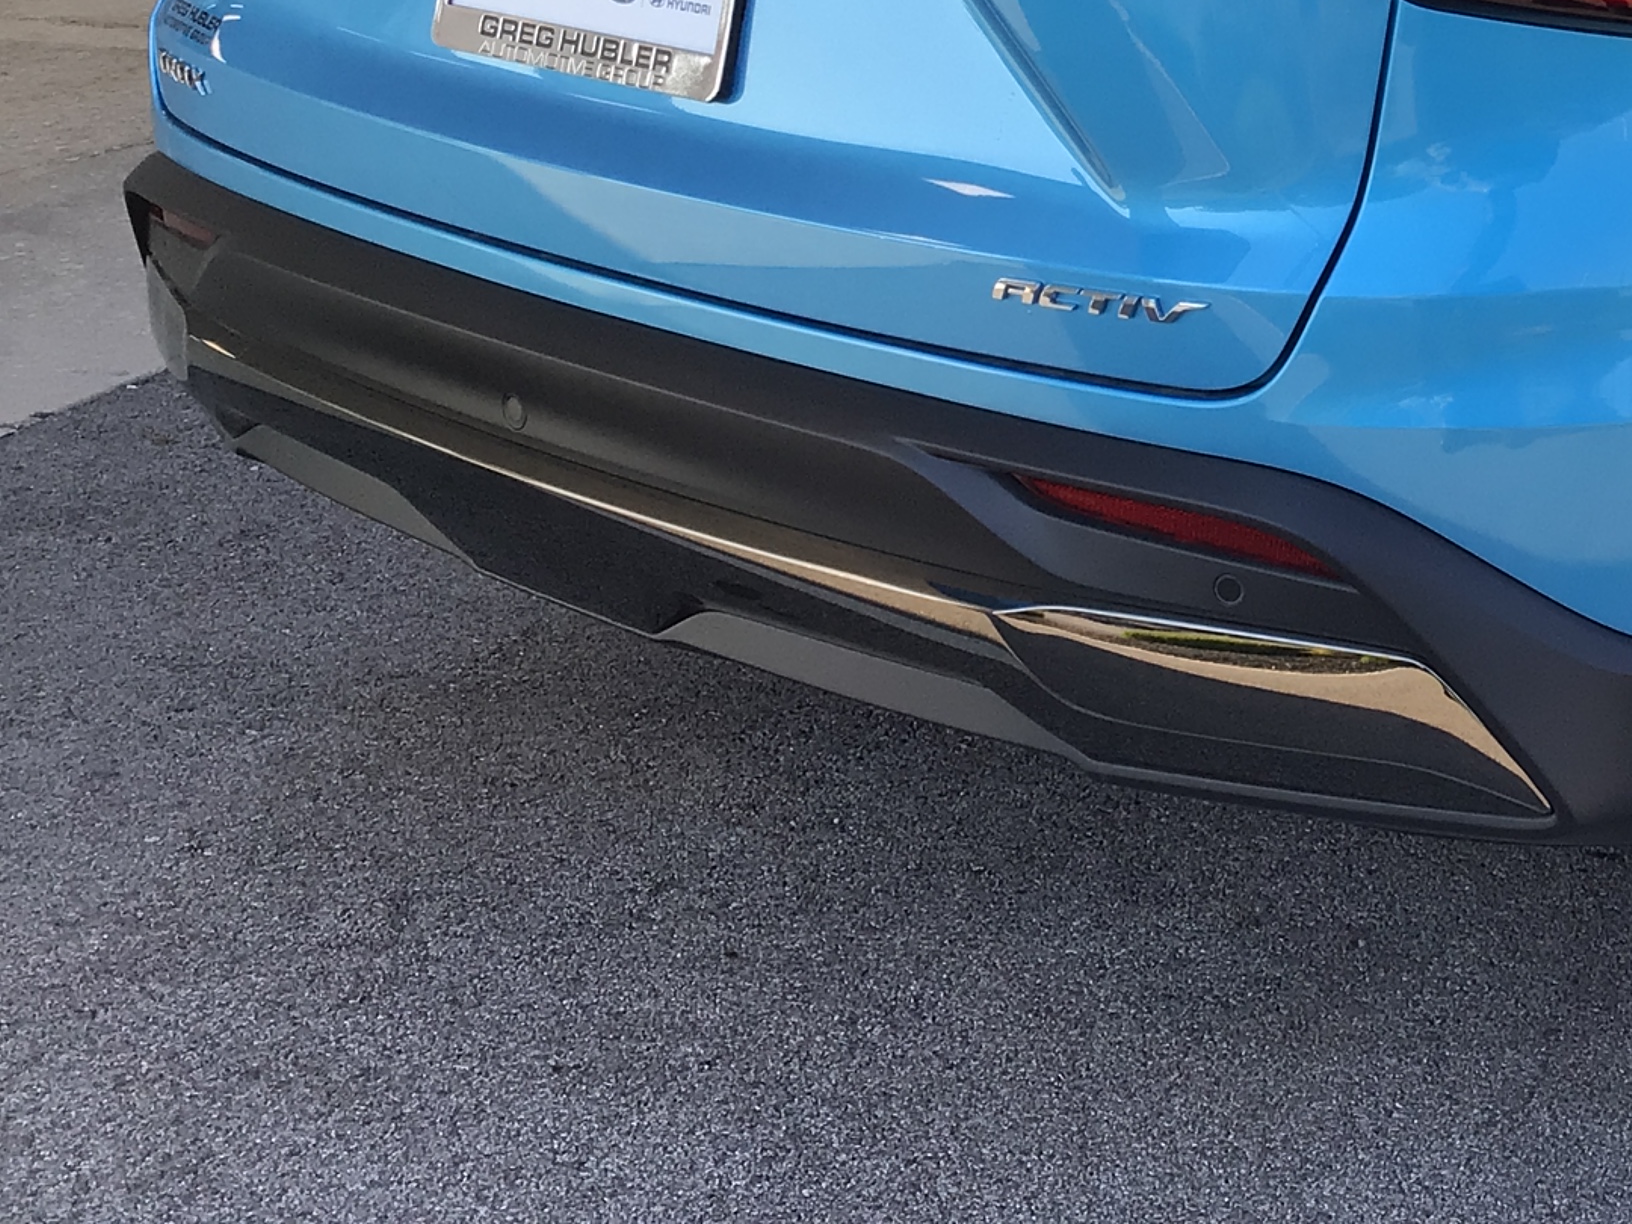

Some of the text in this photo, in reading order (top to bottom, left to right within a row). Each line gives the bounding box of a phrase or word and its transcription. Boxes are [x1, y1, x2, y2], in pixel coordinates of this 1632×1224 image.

[478, 13, 672, 74] GREG HUBLER
[478, 40, 594, 78] AUTOMOTIVE
[992, 277, 1211, 324] ACTIV
